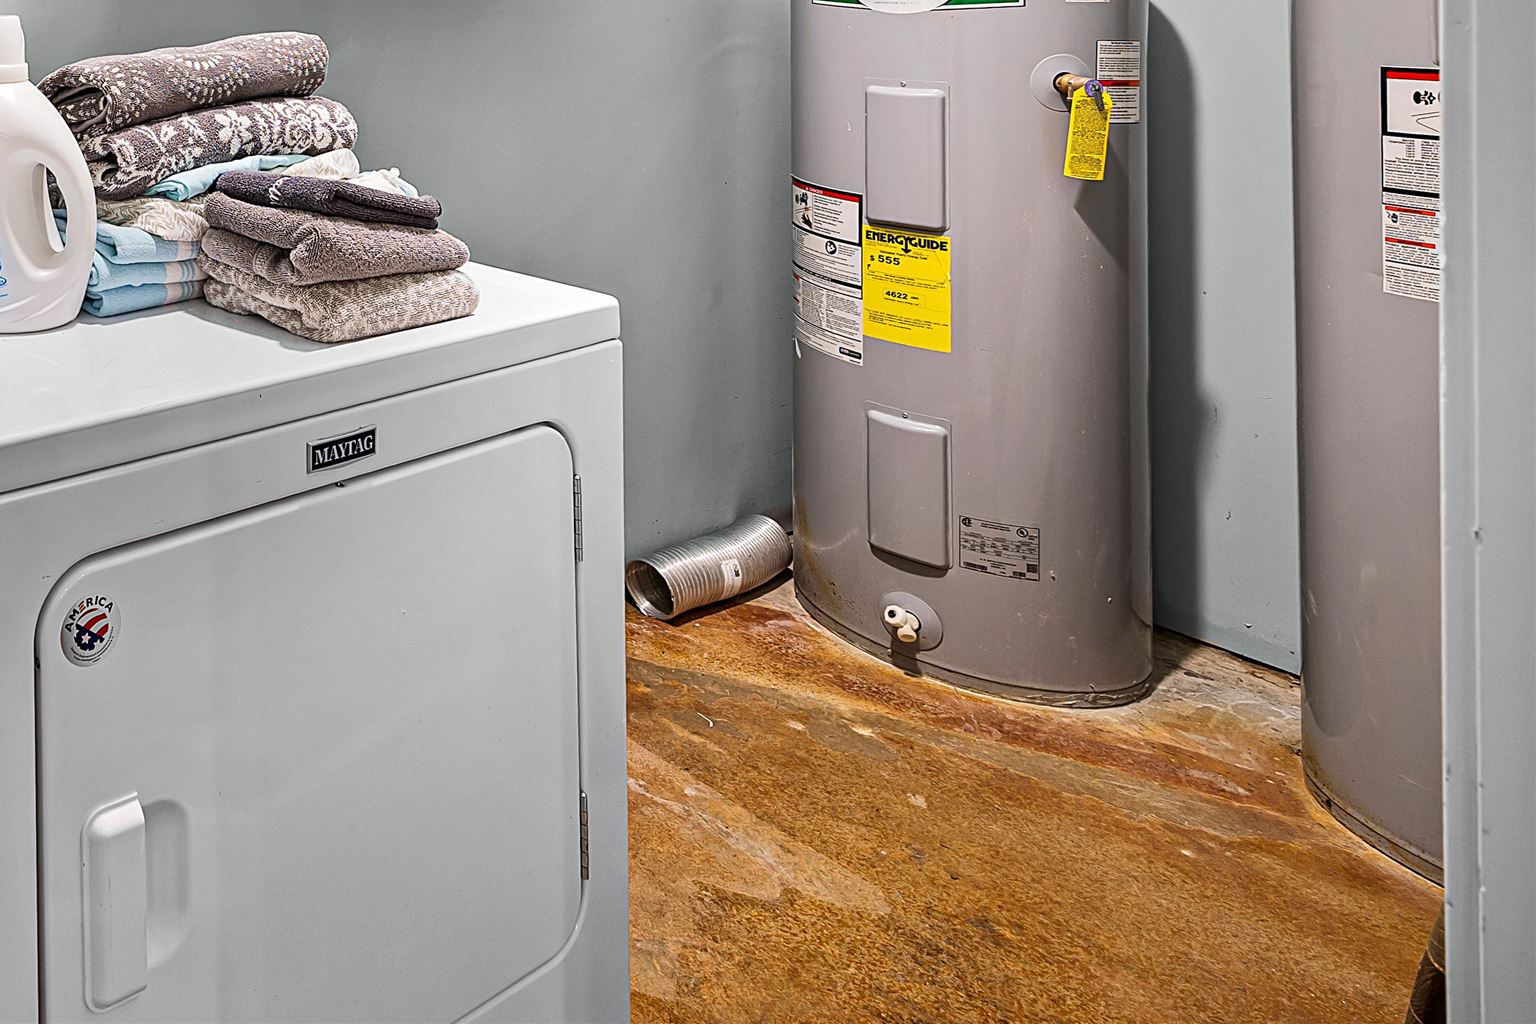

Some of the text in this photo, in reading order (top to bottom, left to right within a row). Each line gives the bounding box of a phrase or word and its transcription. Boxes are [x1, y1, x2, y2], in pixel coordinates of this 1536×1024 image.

[878, 255, 901, 266] 555
[885, 290, 908, 300] 4622
[314, 435, 373, 466] MAYTAG
[65, 596, 114, 633] AMERICA
